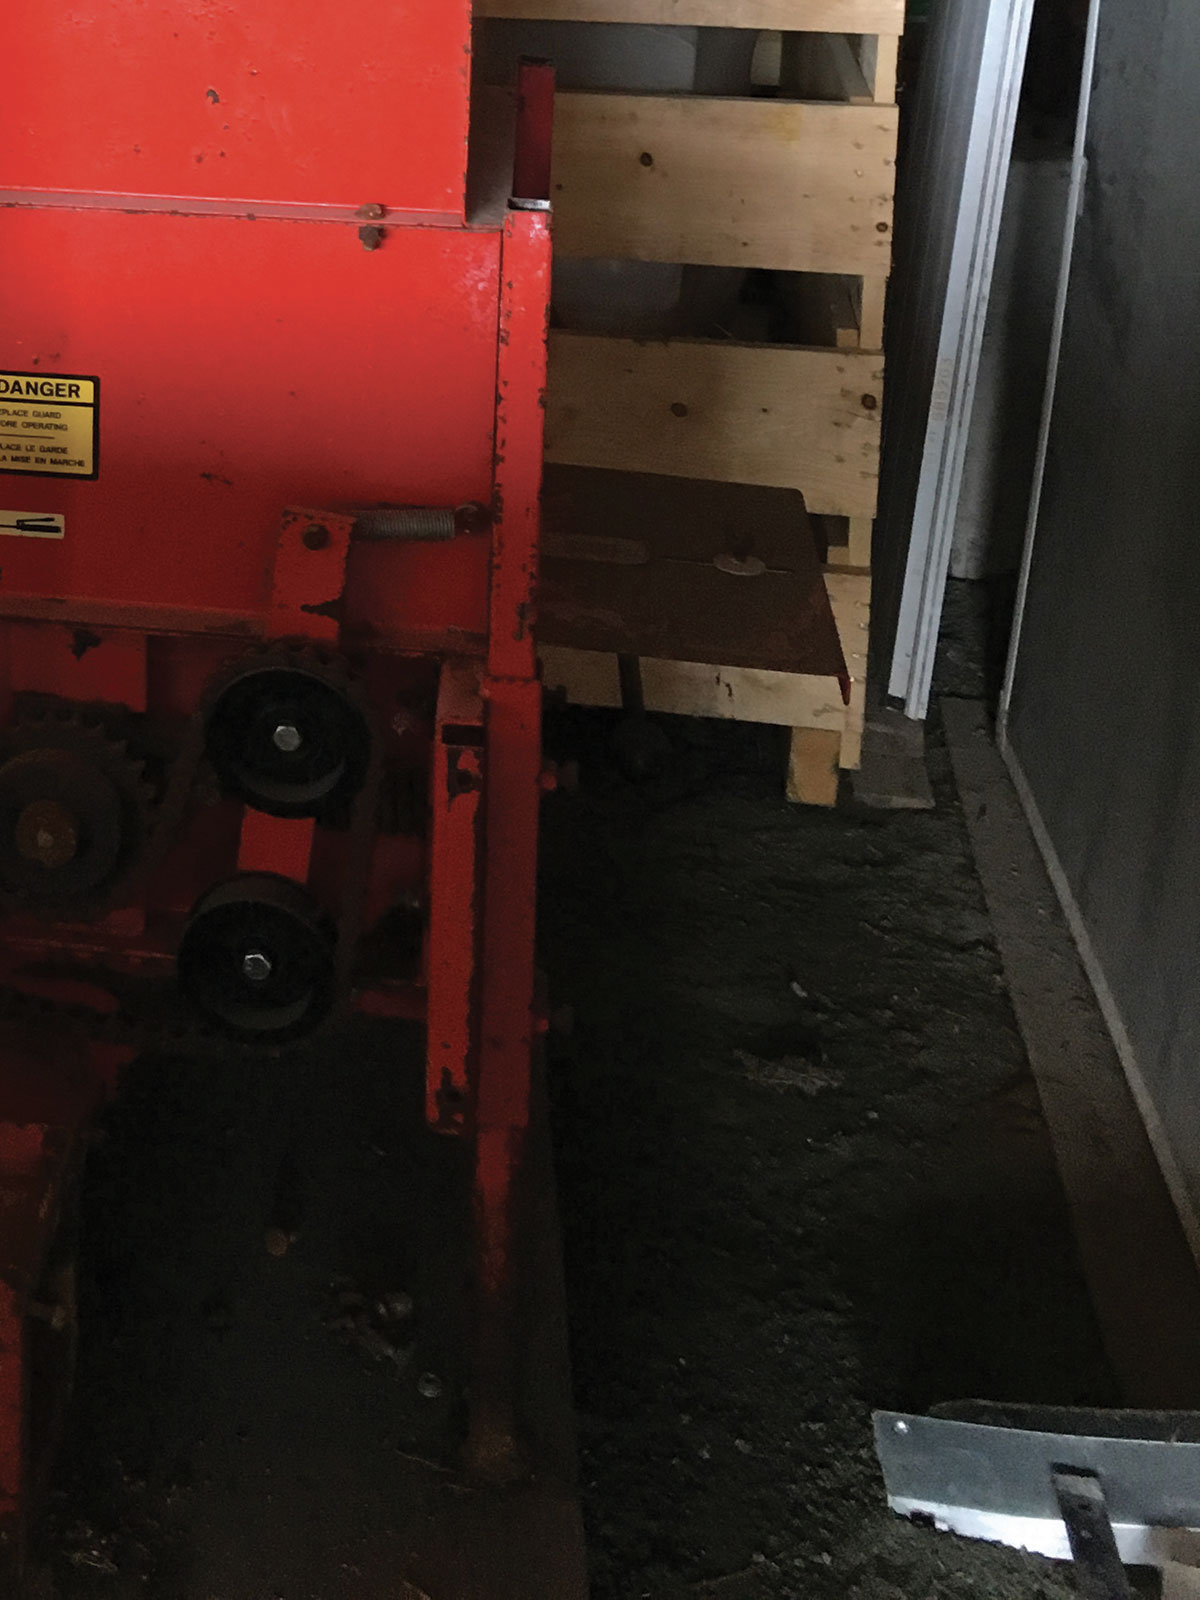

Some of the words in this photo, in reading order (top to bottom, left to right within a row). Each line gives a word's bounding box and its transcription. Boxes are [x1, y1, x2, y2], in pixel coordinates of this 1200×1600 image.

[32, 410, 61, 419] GUARD
[21, 421, 68, 431] OPERATING
[25, 444, 36, 452] LE
[39, 445, 68, 454] GARDE
[11, 455, 31, 463] MISE
[50, 458, 85, 467] MARCHE
